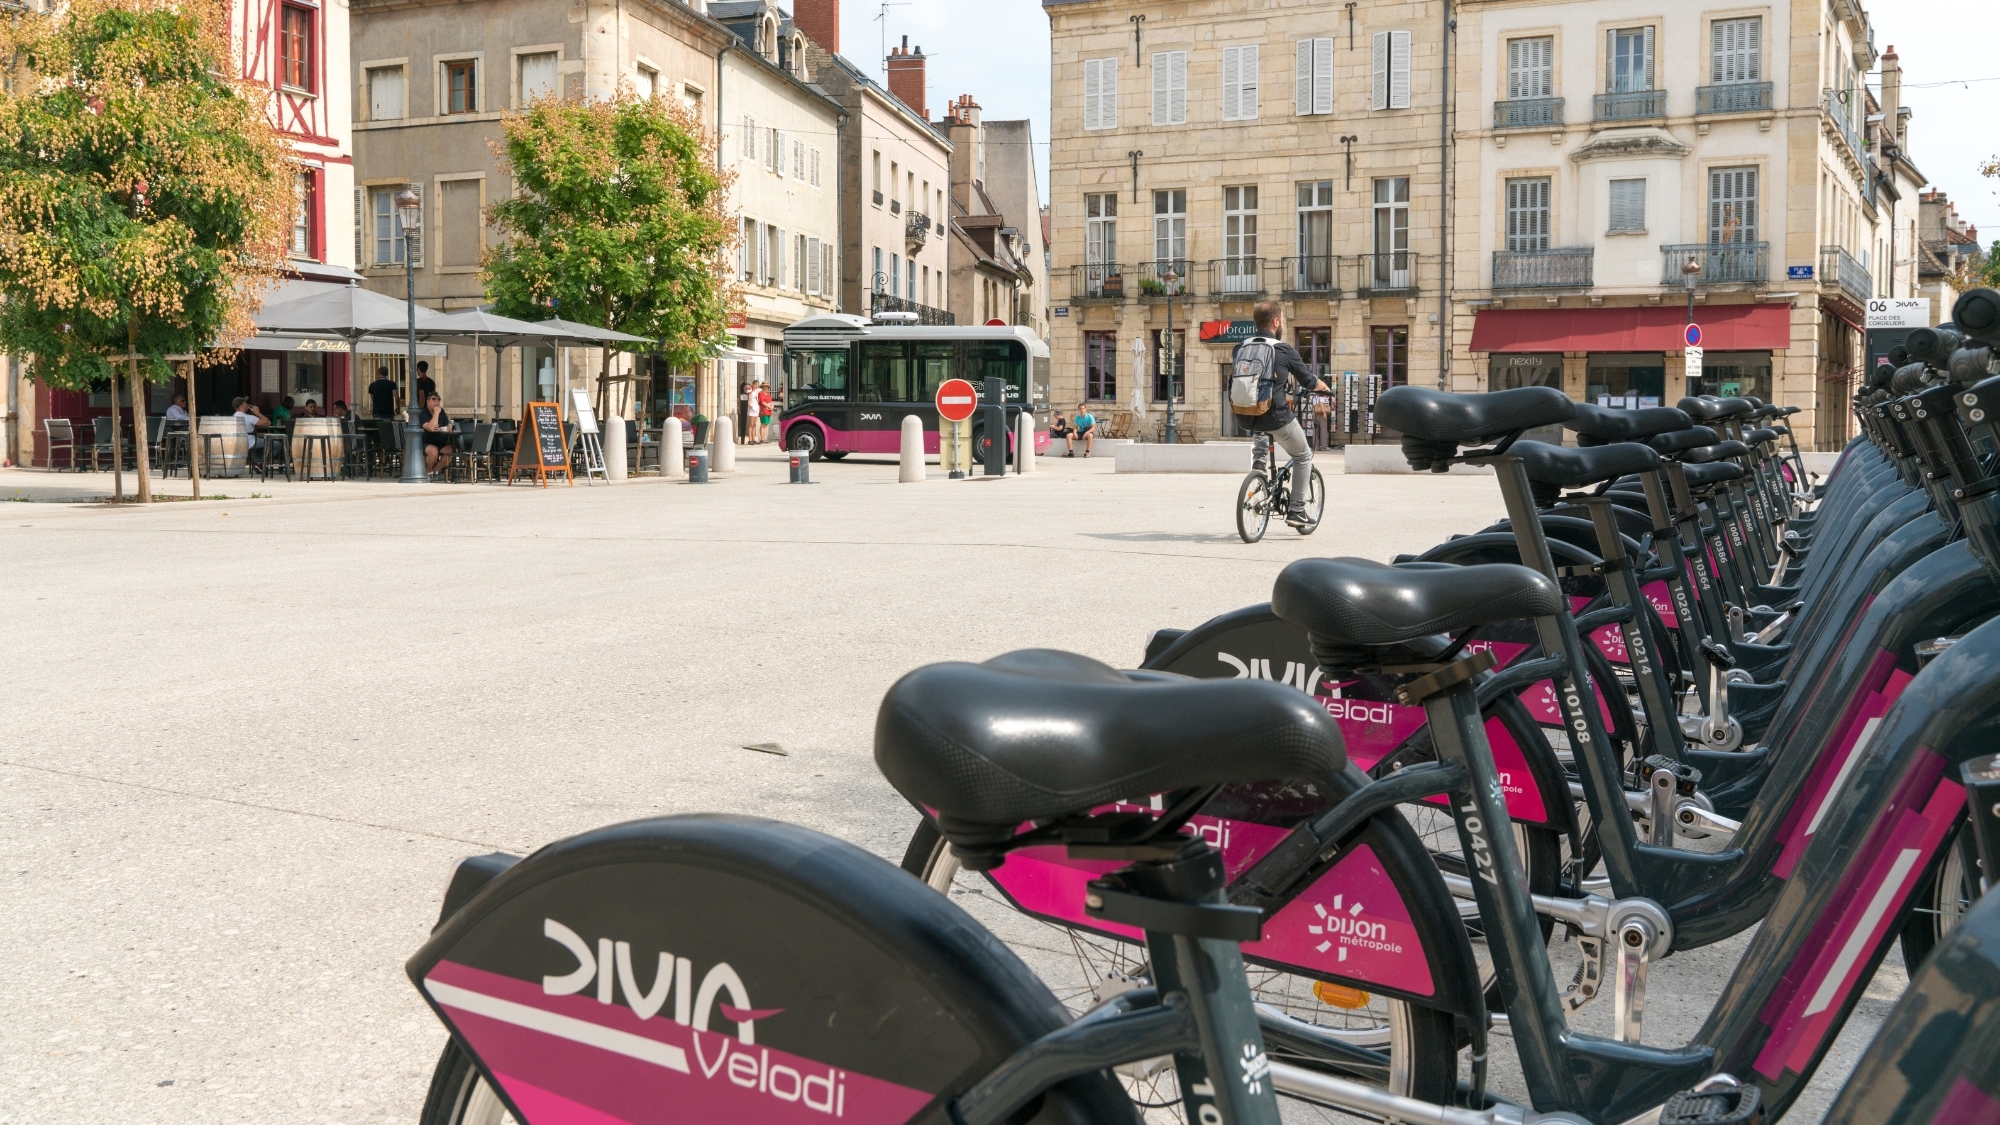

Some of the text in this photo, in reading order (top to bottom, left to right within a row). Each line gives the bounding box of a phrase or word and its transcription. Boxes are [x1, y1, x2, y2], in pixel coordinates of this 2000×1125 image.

[1869, 300, 1887, 312] 06
[1219, 323, 1258, 335] Librairi
[296, 339, 350, 351] Le Déclic
[1509, 356, 1542, 366] nexity
[1742, 509, 1753, 532] 10260
[1754, 500, 1764, 519] 10222
[1728, 522, 1742, 547] 10085
[1713, 535, 1728, 563] 10386
[1695, 558, 1711, 590] 10364
[1674, 586, 1692, 622] 10261
[1629, 628, 1652, 675] 10214
[1563, 683, 1591, 744] 10108
[1460, 801, 1498, 885] 10427
[1339, 935, 1402, 953] métropole
[692, 1030, 845, 1117] Velodi
